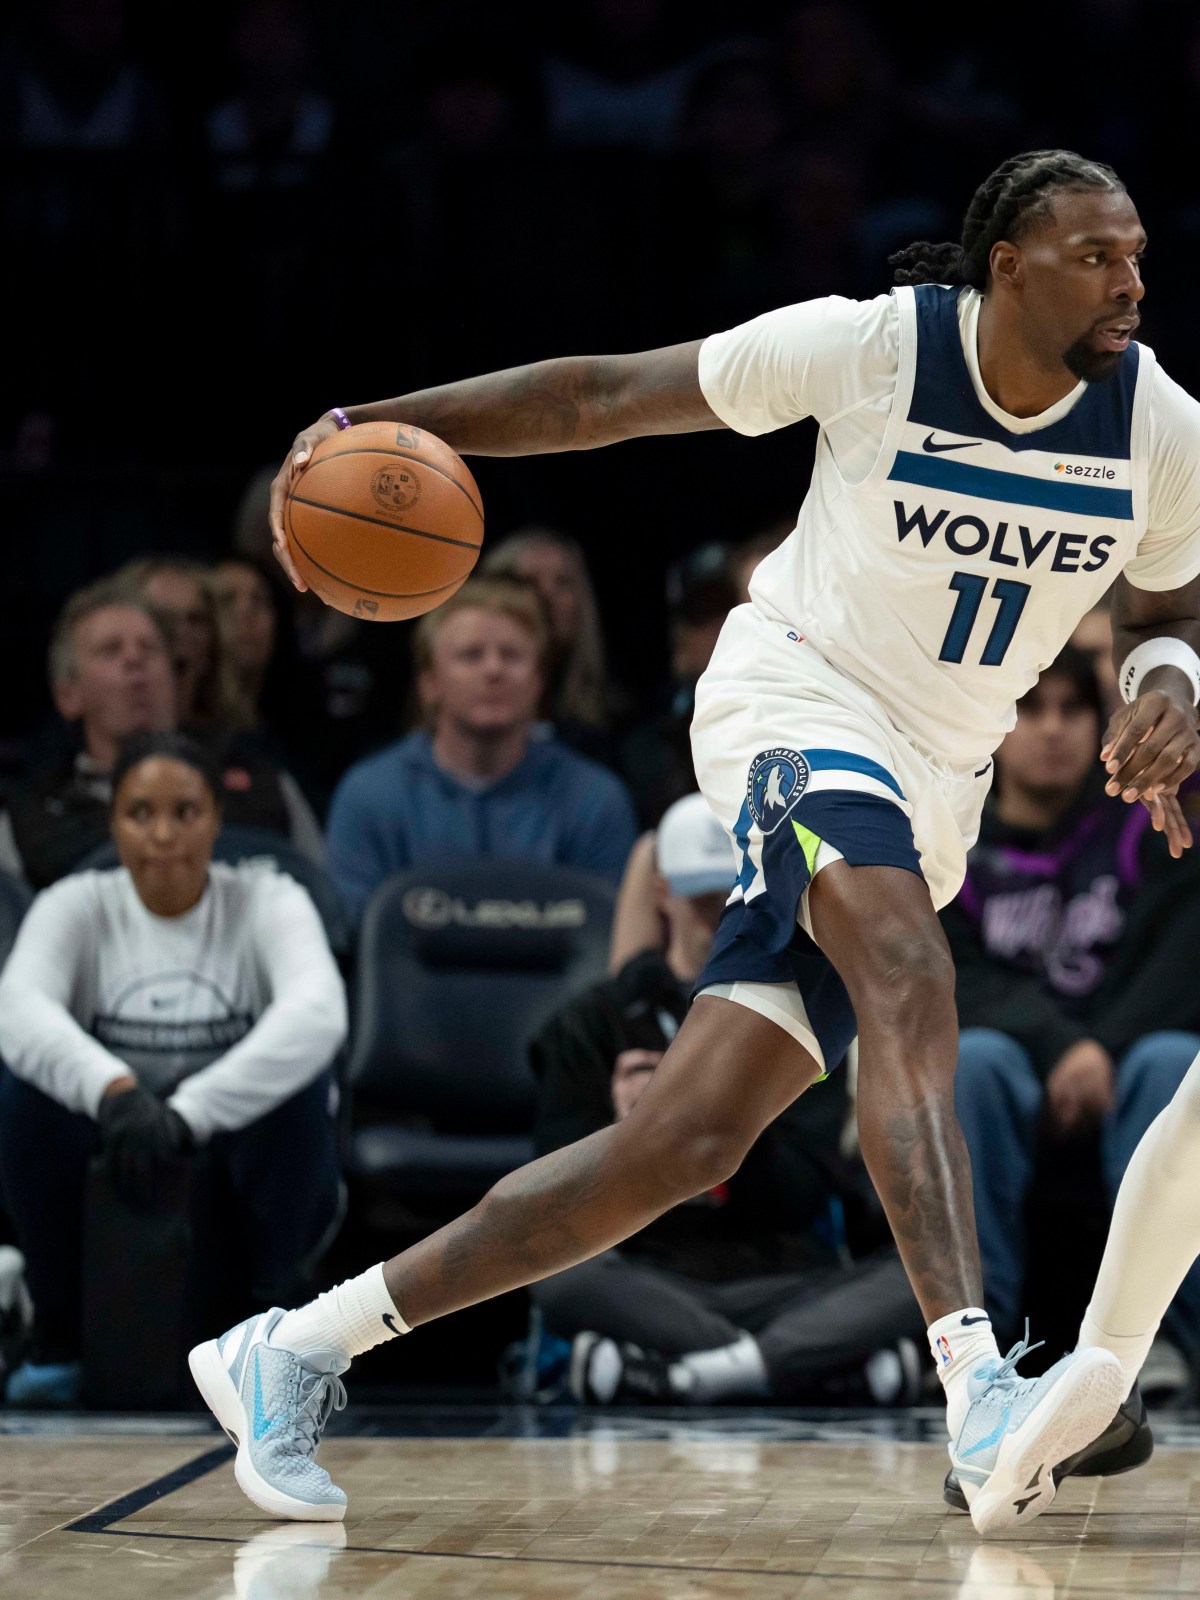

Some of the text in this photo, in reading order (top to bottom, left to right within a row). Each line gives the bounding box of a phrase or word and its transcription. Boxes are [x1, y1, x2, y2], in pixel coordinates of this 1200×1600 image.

[1065, 463, 1116, 480] sezzle
[893, 500, 1117, 573] WOLVES
[938, 571, 1032, 667] 11
[764, 750, 806, 797] TIMBERWOLVES
